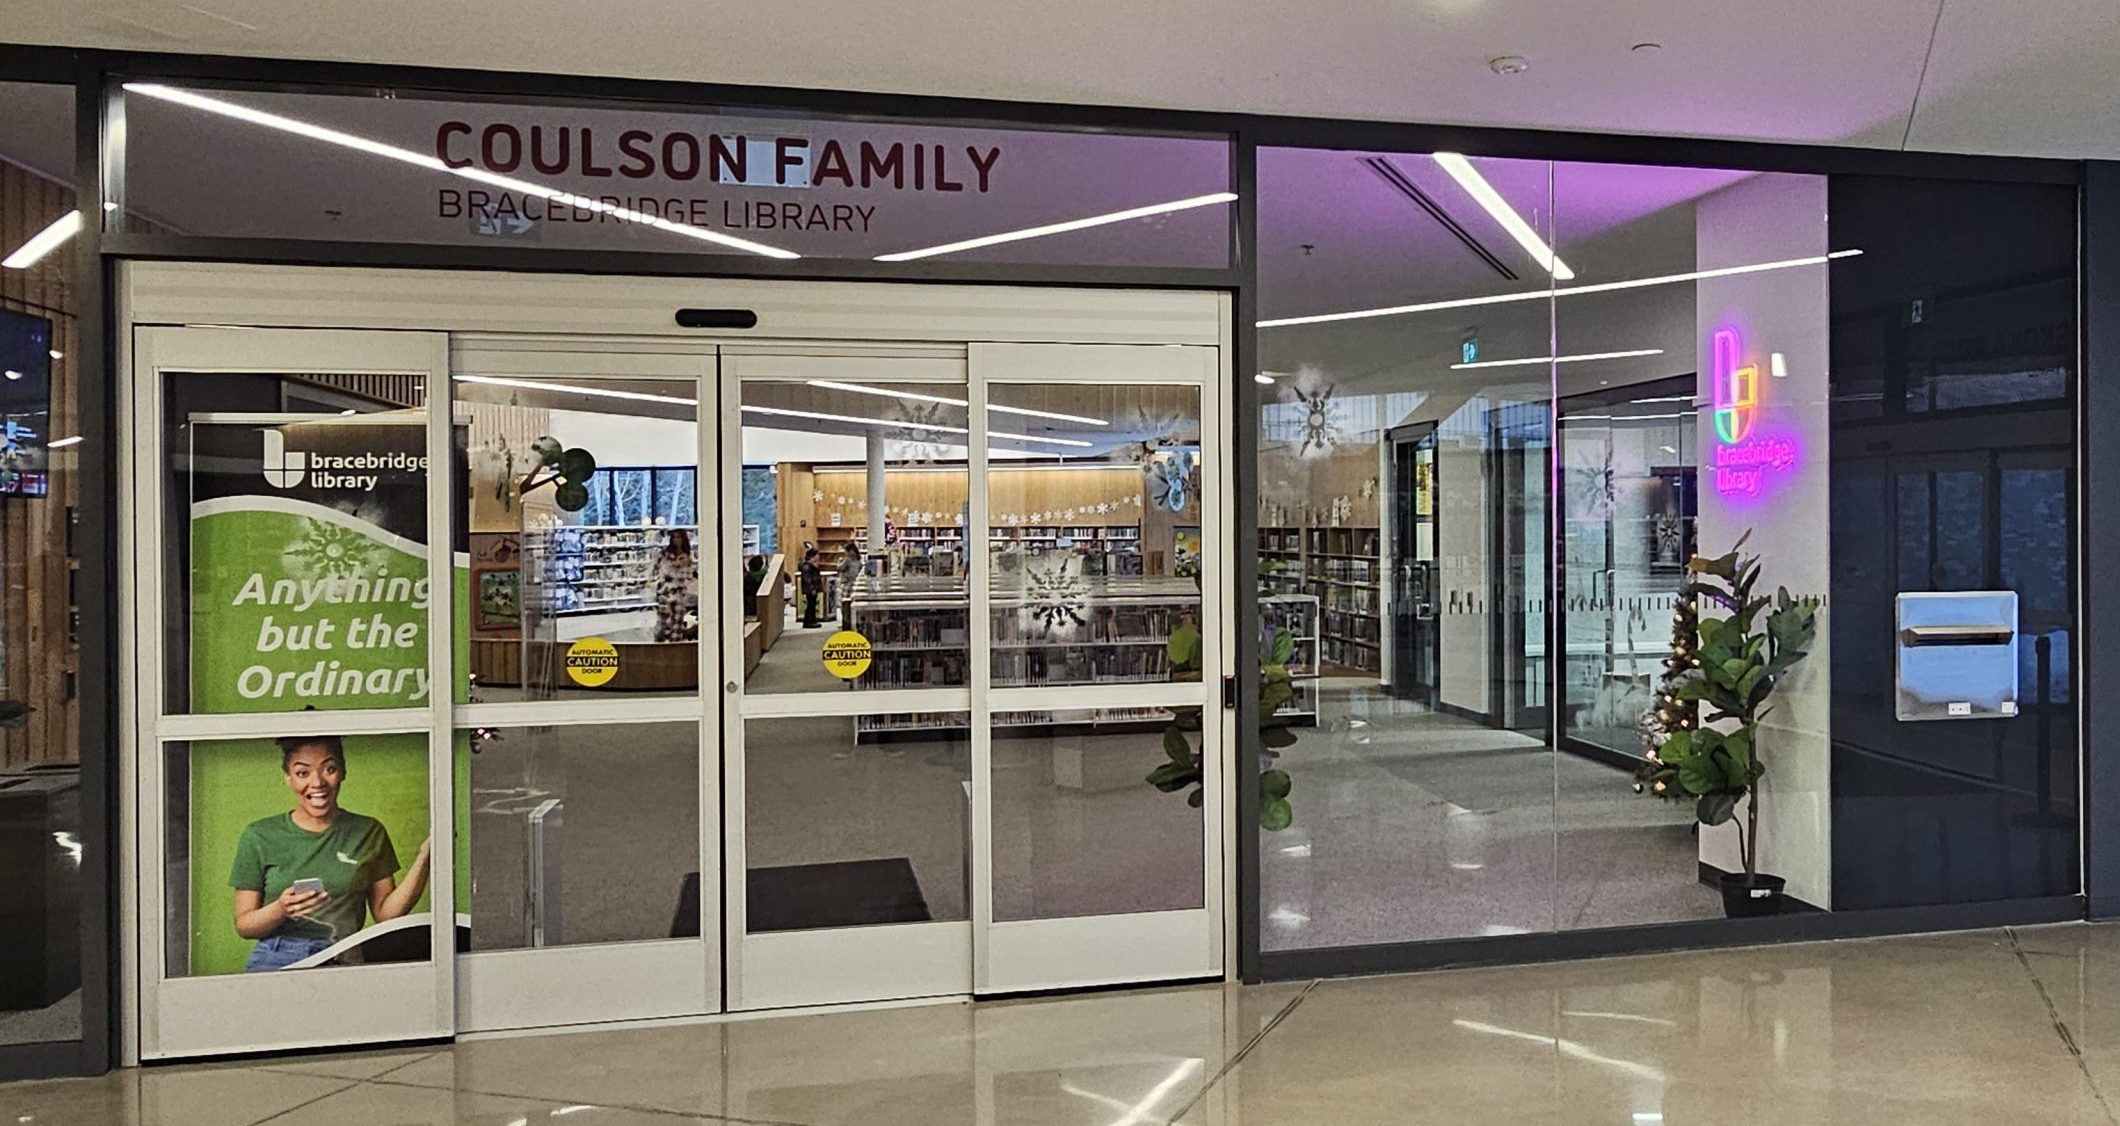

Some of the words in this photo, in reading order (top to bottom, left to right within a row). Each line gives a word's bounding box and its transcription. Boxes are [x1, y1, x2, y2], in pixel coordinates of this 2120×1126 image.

[435, 121, 747, 183] COULSON
[775, 137, 1000, 193] FAMILY
[438, 189, 709, 227] BRACEBRIDGE
[724, 200, 876, 233] LIBRARY
[311, 452, 428, 473] bracebridge
[311, 472, 378, 491] library
[1717, 468, 1758, 492] library
[232, 567, 429, 612] Anything
[256, 616, 335, 652] but
[346, 613, 418, 648] the
[567, 657, 618, 666] CAUTION
[824, 650, 871, 659] CAUTION
[237, 660, 430, 700] Ordinary
